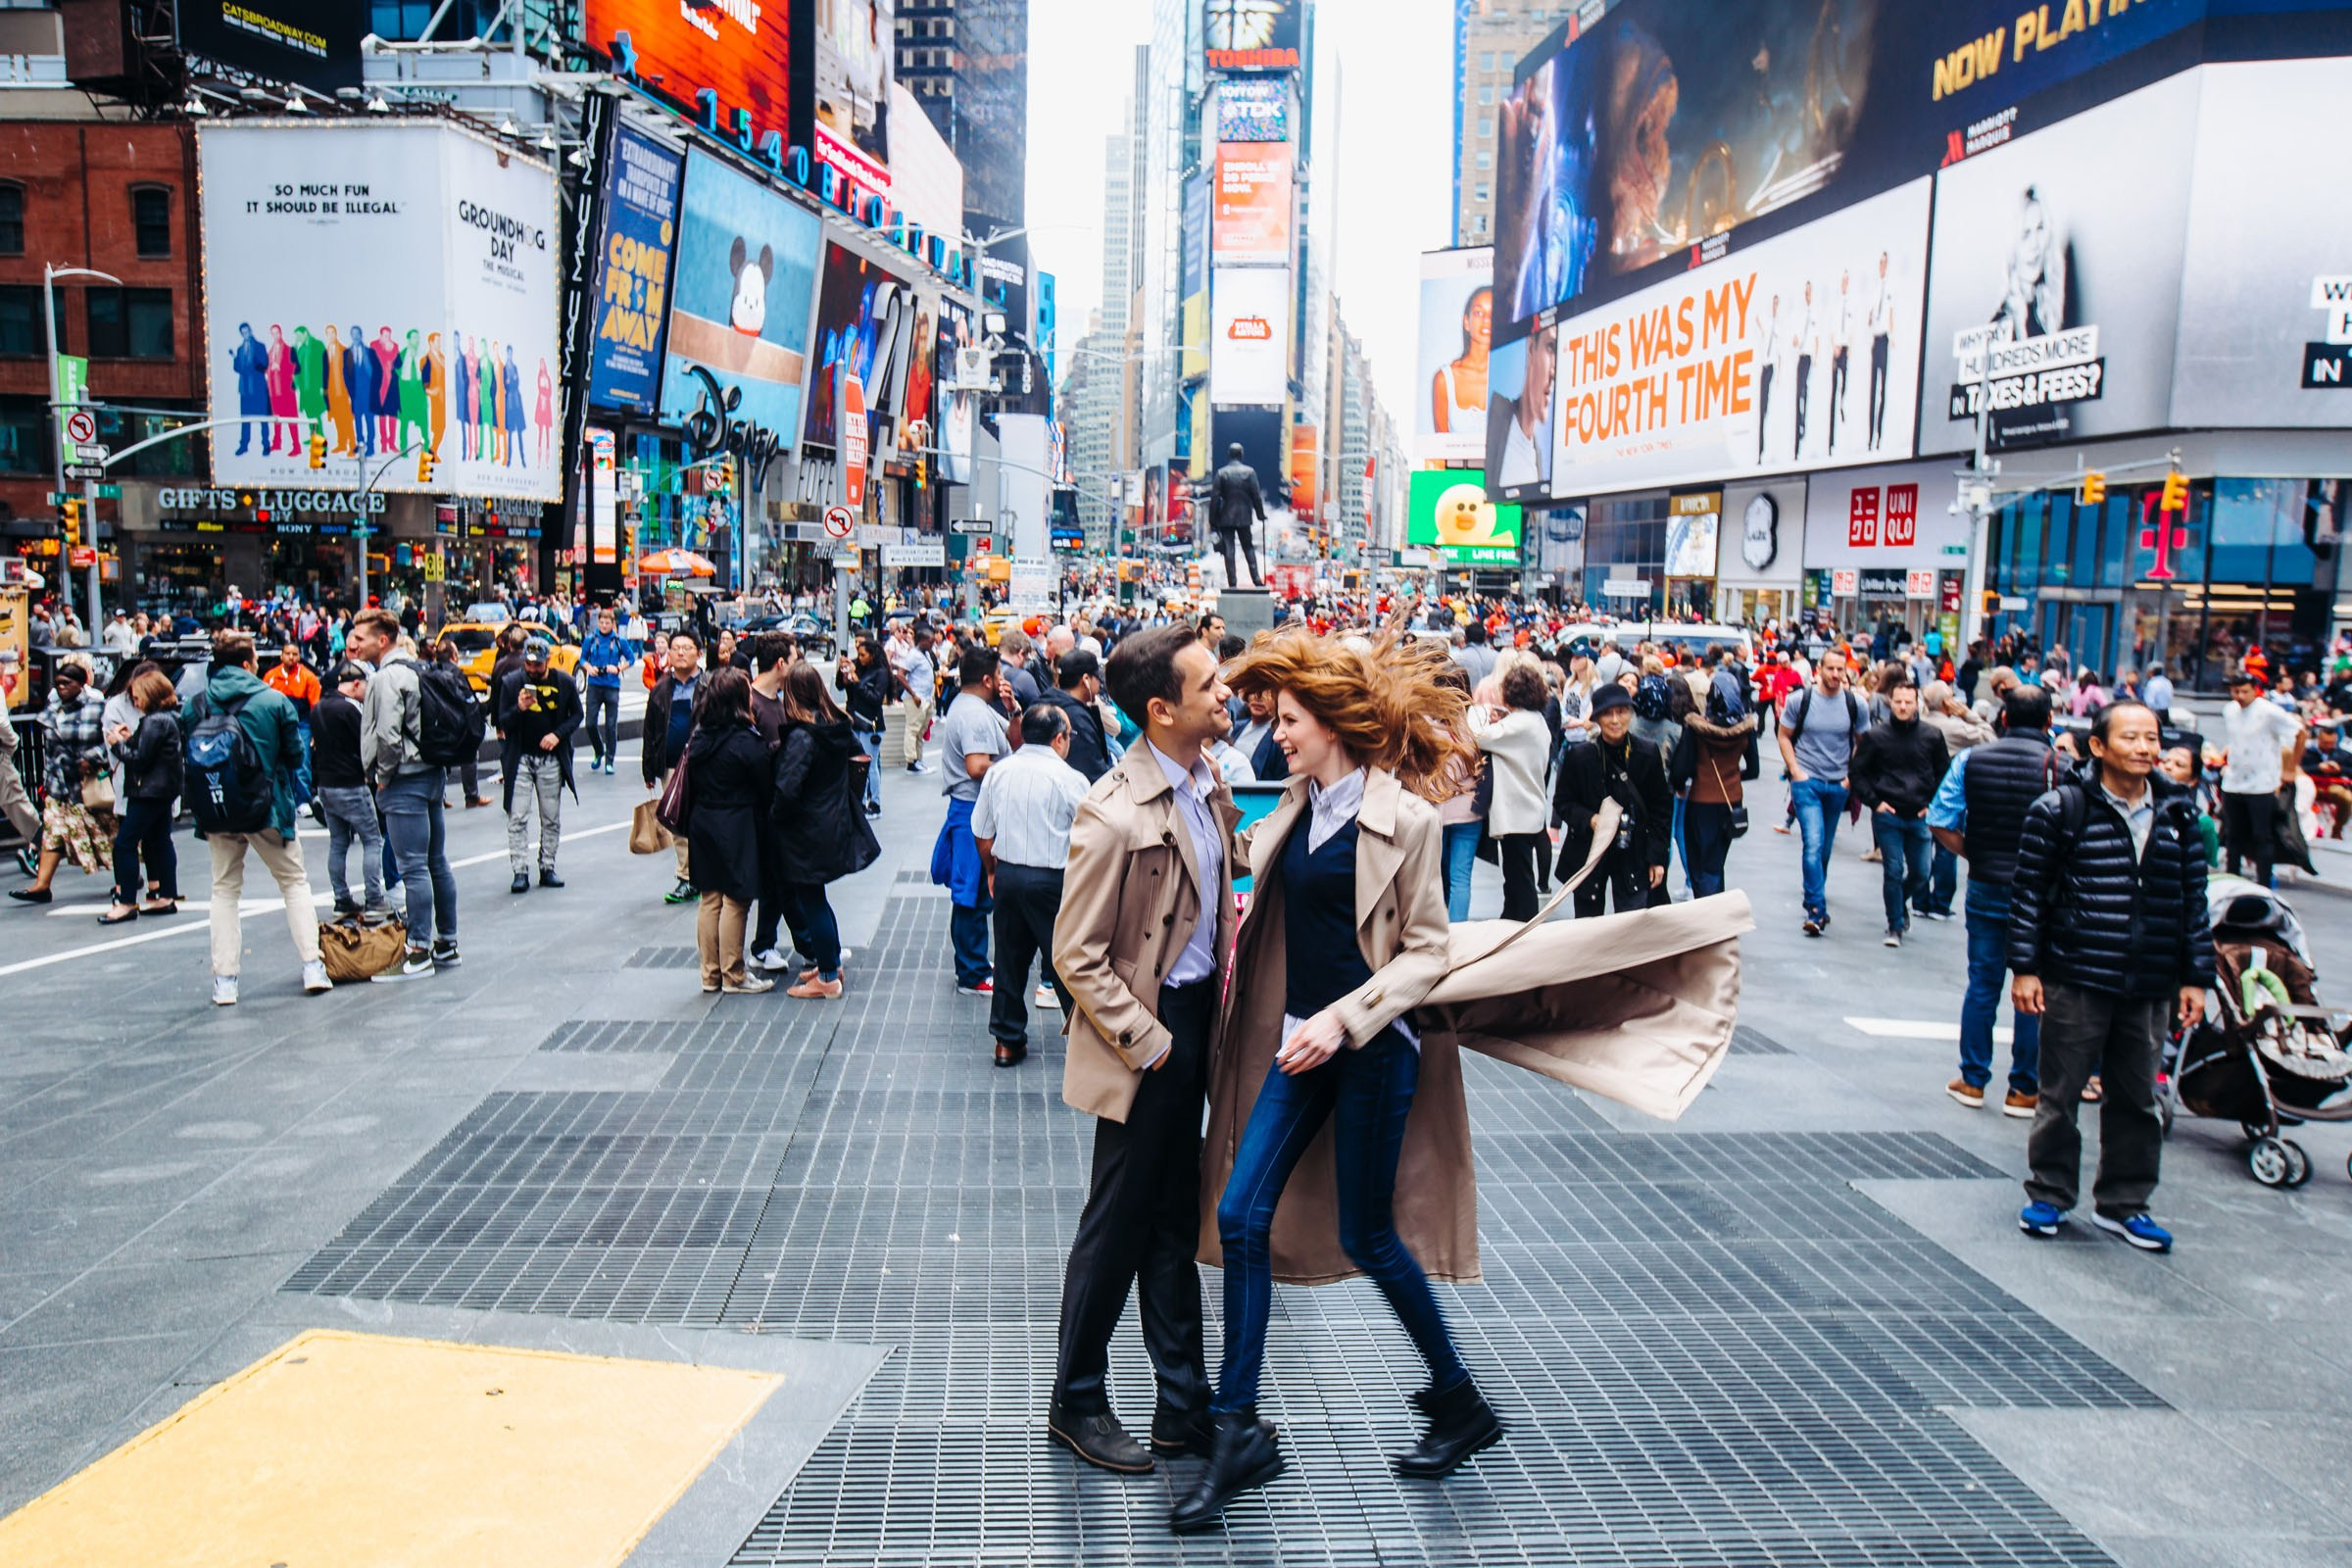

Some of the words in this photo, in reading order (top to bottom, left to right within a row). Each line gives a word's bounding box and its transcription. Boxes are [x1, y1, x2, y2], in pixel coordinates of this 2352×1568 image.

[1206, 48, 1299, 68] TOSHIBA
[1933, 26, 2006, 102] NOW
[2013, 0, 2146, 63] PLAY
[1237, 101, 1281, 118] TDK
[696, 88, 809, 186] 1540
[300, 184, 338, 196] MUCH
[345, 184, 369, 196] FUN
[247, 202, 259, 214] IT
[267, 202, 318, 214] SHOULD
[322, 202, 338, 214] BE
[459, 199, 545, 251] GROUNDHOG
[491, 235, 514, 264] DAY
[609, 231, 667, 284] COME
[497, 264, 524, 282] MUSICAL
[599, 304, 661, 353] AWAY
[1569, 321, 1622, 388] THIS
[1629, 296, 1695, 370] WAS
[1702, 271, 1757, 350] MY
[2045, 332, 2091, 360] MORE
[2313, 357, 2342, 382] IN
[1564, 370, 1668, 447] FOURTH
[1677, 348, 1753, 424] TIME
[1952, 396, 1966, 416] IN
[158, 488, 236, 510] GIFTS
[259, 491, 386, 514] LUGGAGE
[493, 496, 544, 517] LUGGAGE
[1888, 492, 1912, 514] UNI
[277, 524, 312, 533] SONY
[1886, 515, 1913, 544] QLO
[1472, 549, 1494, 560] LINE
